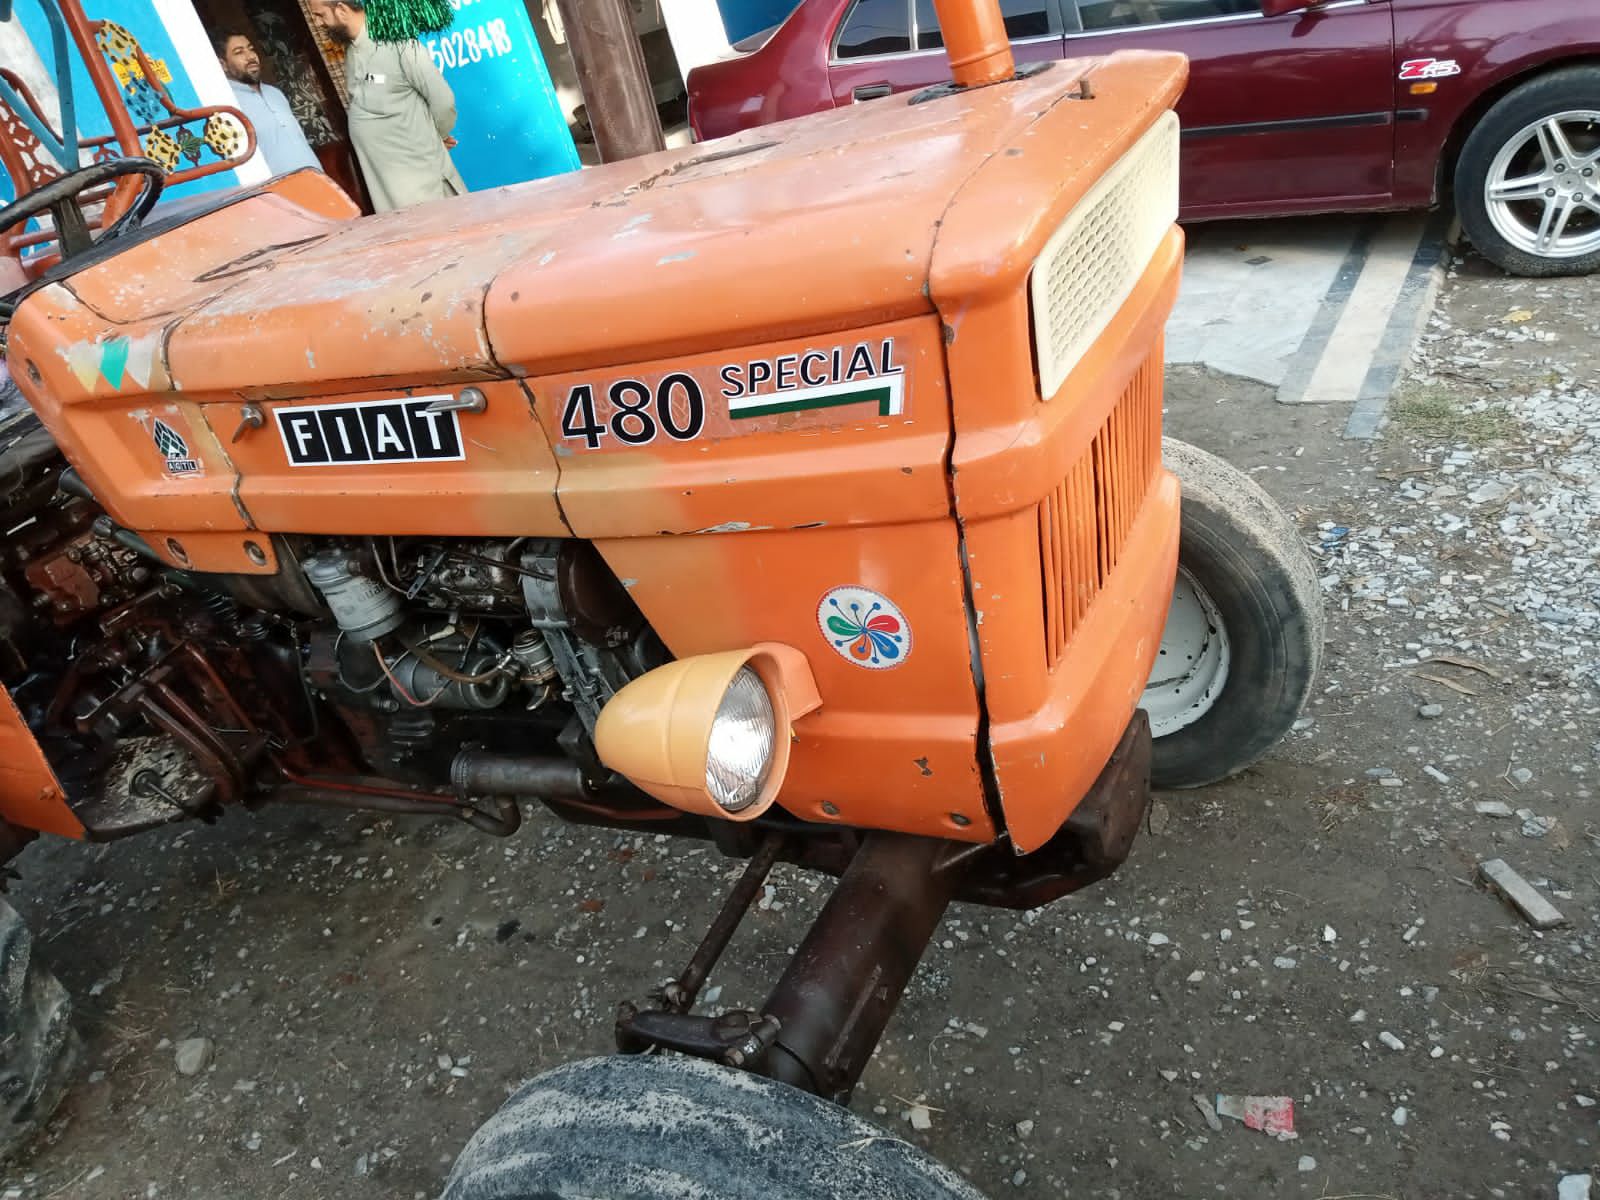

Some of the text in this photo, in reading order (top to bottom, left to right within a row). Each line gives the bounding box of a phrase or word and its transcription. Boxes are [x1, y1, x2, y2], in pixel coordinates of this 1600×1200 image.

[288, 407, 445, 458] FIAT
[560, 336, 905, 450] 480 SPECIAL
